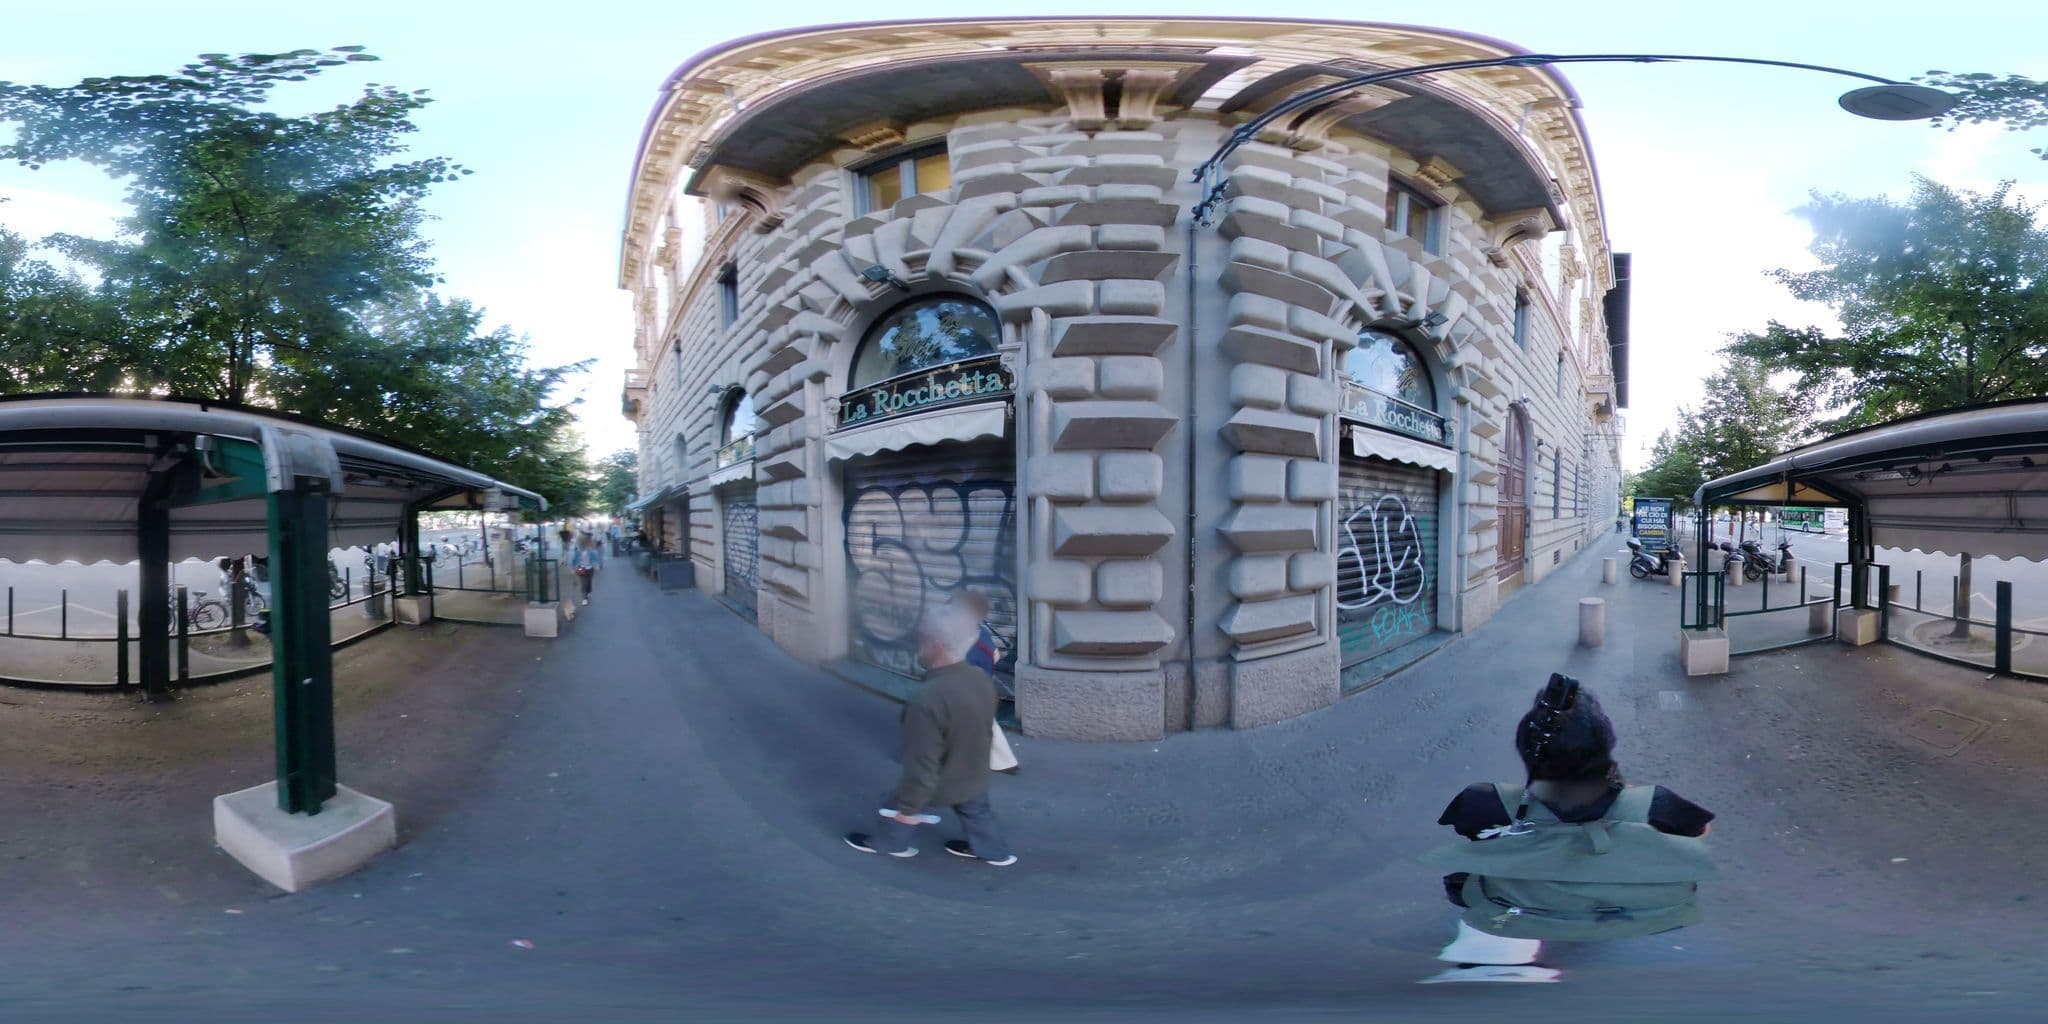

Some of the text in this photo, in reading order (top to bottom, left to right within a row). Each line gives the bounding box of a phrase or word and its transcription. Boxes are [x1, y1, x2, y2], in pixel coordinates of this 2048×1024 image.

[842, 370, 1004, 424] La Rocchetta
[1343, 389, 1442, 440] La Rocchetta
